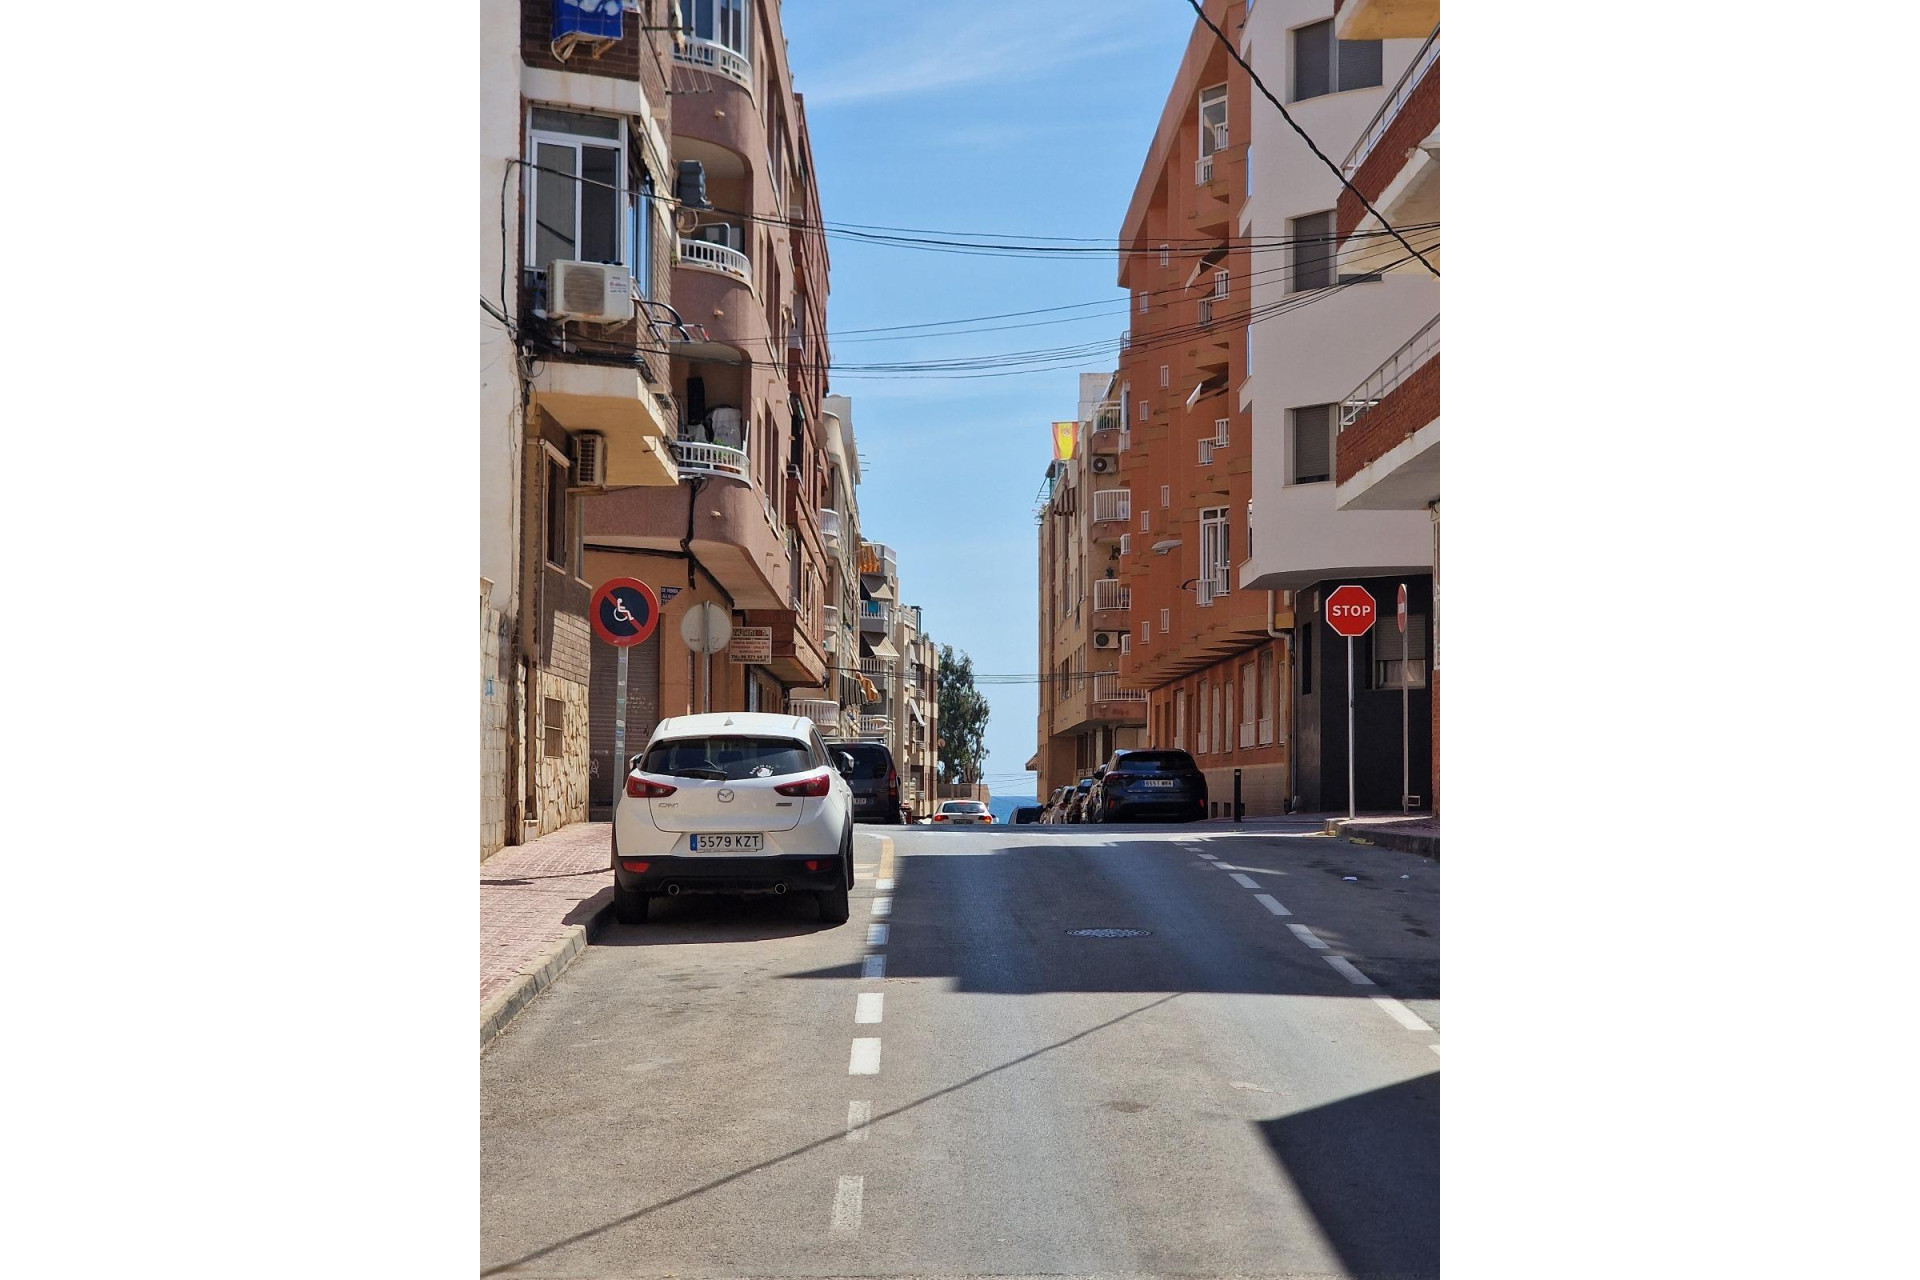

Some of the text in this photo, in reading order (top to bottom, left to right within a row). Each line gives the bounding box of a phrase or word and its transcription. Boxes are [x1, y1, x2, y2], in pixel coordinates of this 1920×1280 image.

[1332, 605, 1371, 617] STOP
[700, 835, 759, 848] 5579 KZT
